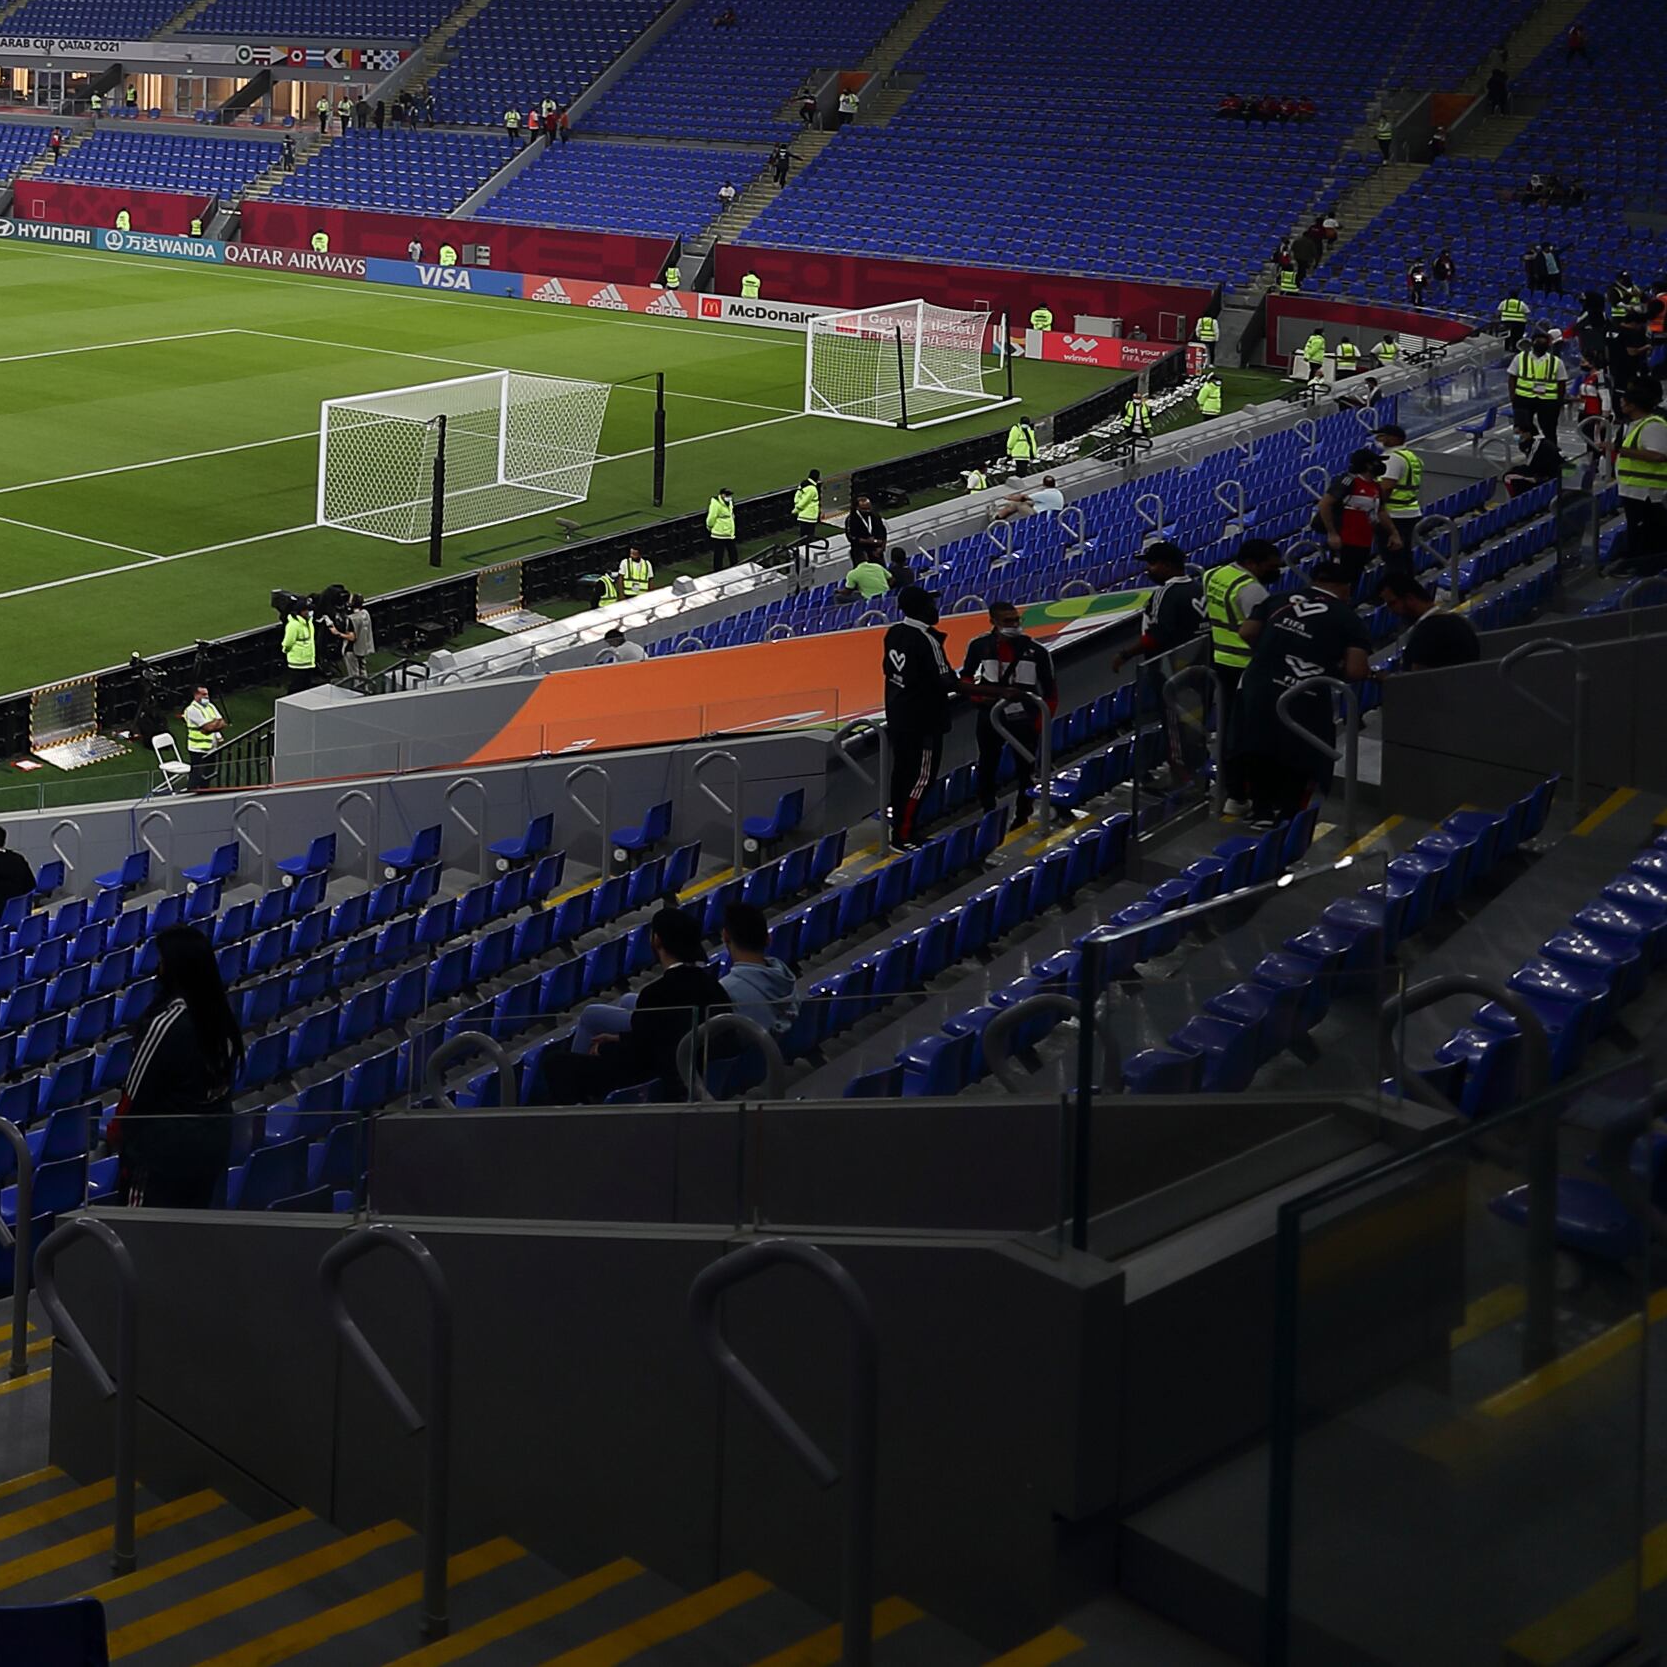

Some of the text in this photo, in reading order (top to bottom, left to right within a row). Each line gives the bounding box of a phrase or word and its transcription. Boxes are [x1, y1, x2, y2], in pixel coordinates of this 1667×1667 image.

[0, 37, 31, 49] ARAB
[33, 38, 55, 50] CUP
[58, 39, 92, 51] QATAR
[94, 41, 120, 52] 2021
[18, 222, 91, 245] HYUNDAI
[224, 245, 366, 275] QATAR AIRWAYS
[415, 265, 471, 290] VISA
[531, 292, 571, 305] adidas
[586, 298, 629, 312] adidas
[645, 304, 688, 318] adidas
[869, 313, 894, 325] Get
[1122, 346, 1138, 354] Get
[1063, 353, 1097, 364] winwin
[1283, 617, 1306, 631] FIFA
